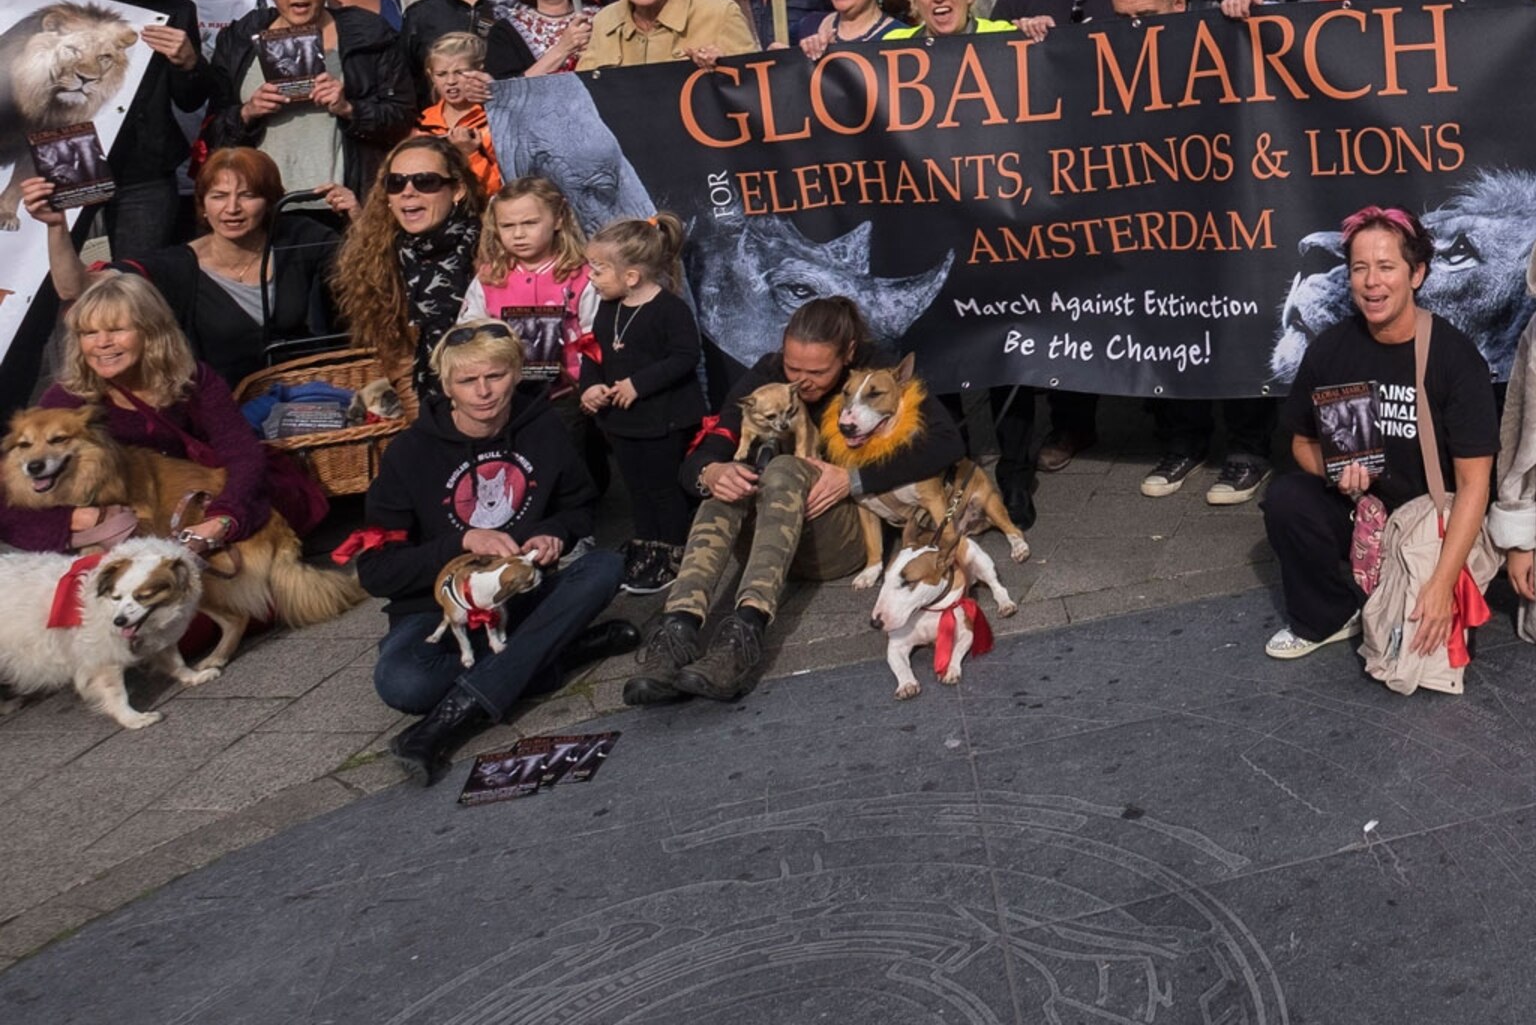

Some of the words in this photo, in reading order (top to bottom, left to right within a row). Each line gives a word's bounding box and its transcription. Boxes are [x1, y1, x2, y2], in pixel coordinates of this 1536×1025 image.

[679, 40, 1062, 149] GLOBAL
[1088, 3, 1458, 117] MARCH
[708, 170, 734, 219] FOR
[737, 152, 1033, 216] ELEPHANTS,
[1049, 133, 1235, 196] RHINOS
[1251, 132, 1290, 180] &
[1305, 122, 1465, 177] LIONS
[967, 209, 1277, 264] AMSTERDAM
[954, 293, 1041, 318] March
[1051, 291, 1135, 321] Against
[1144, 290, 1258, 318] Extinction
[1003, 330, 1036, 356] Be
[1048, 333, 1094, 362] the
[1106, 330, 1212, 372] Change!
[478, 451, 502, 461] BULL
